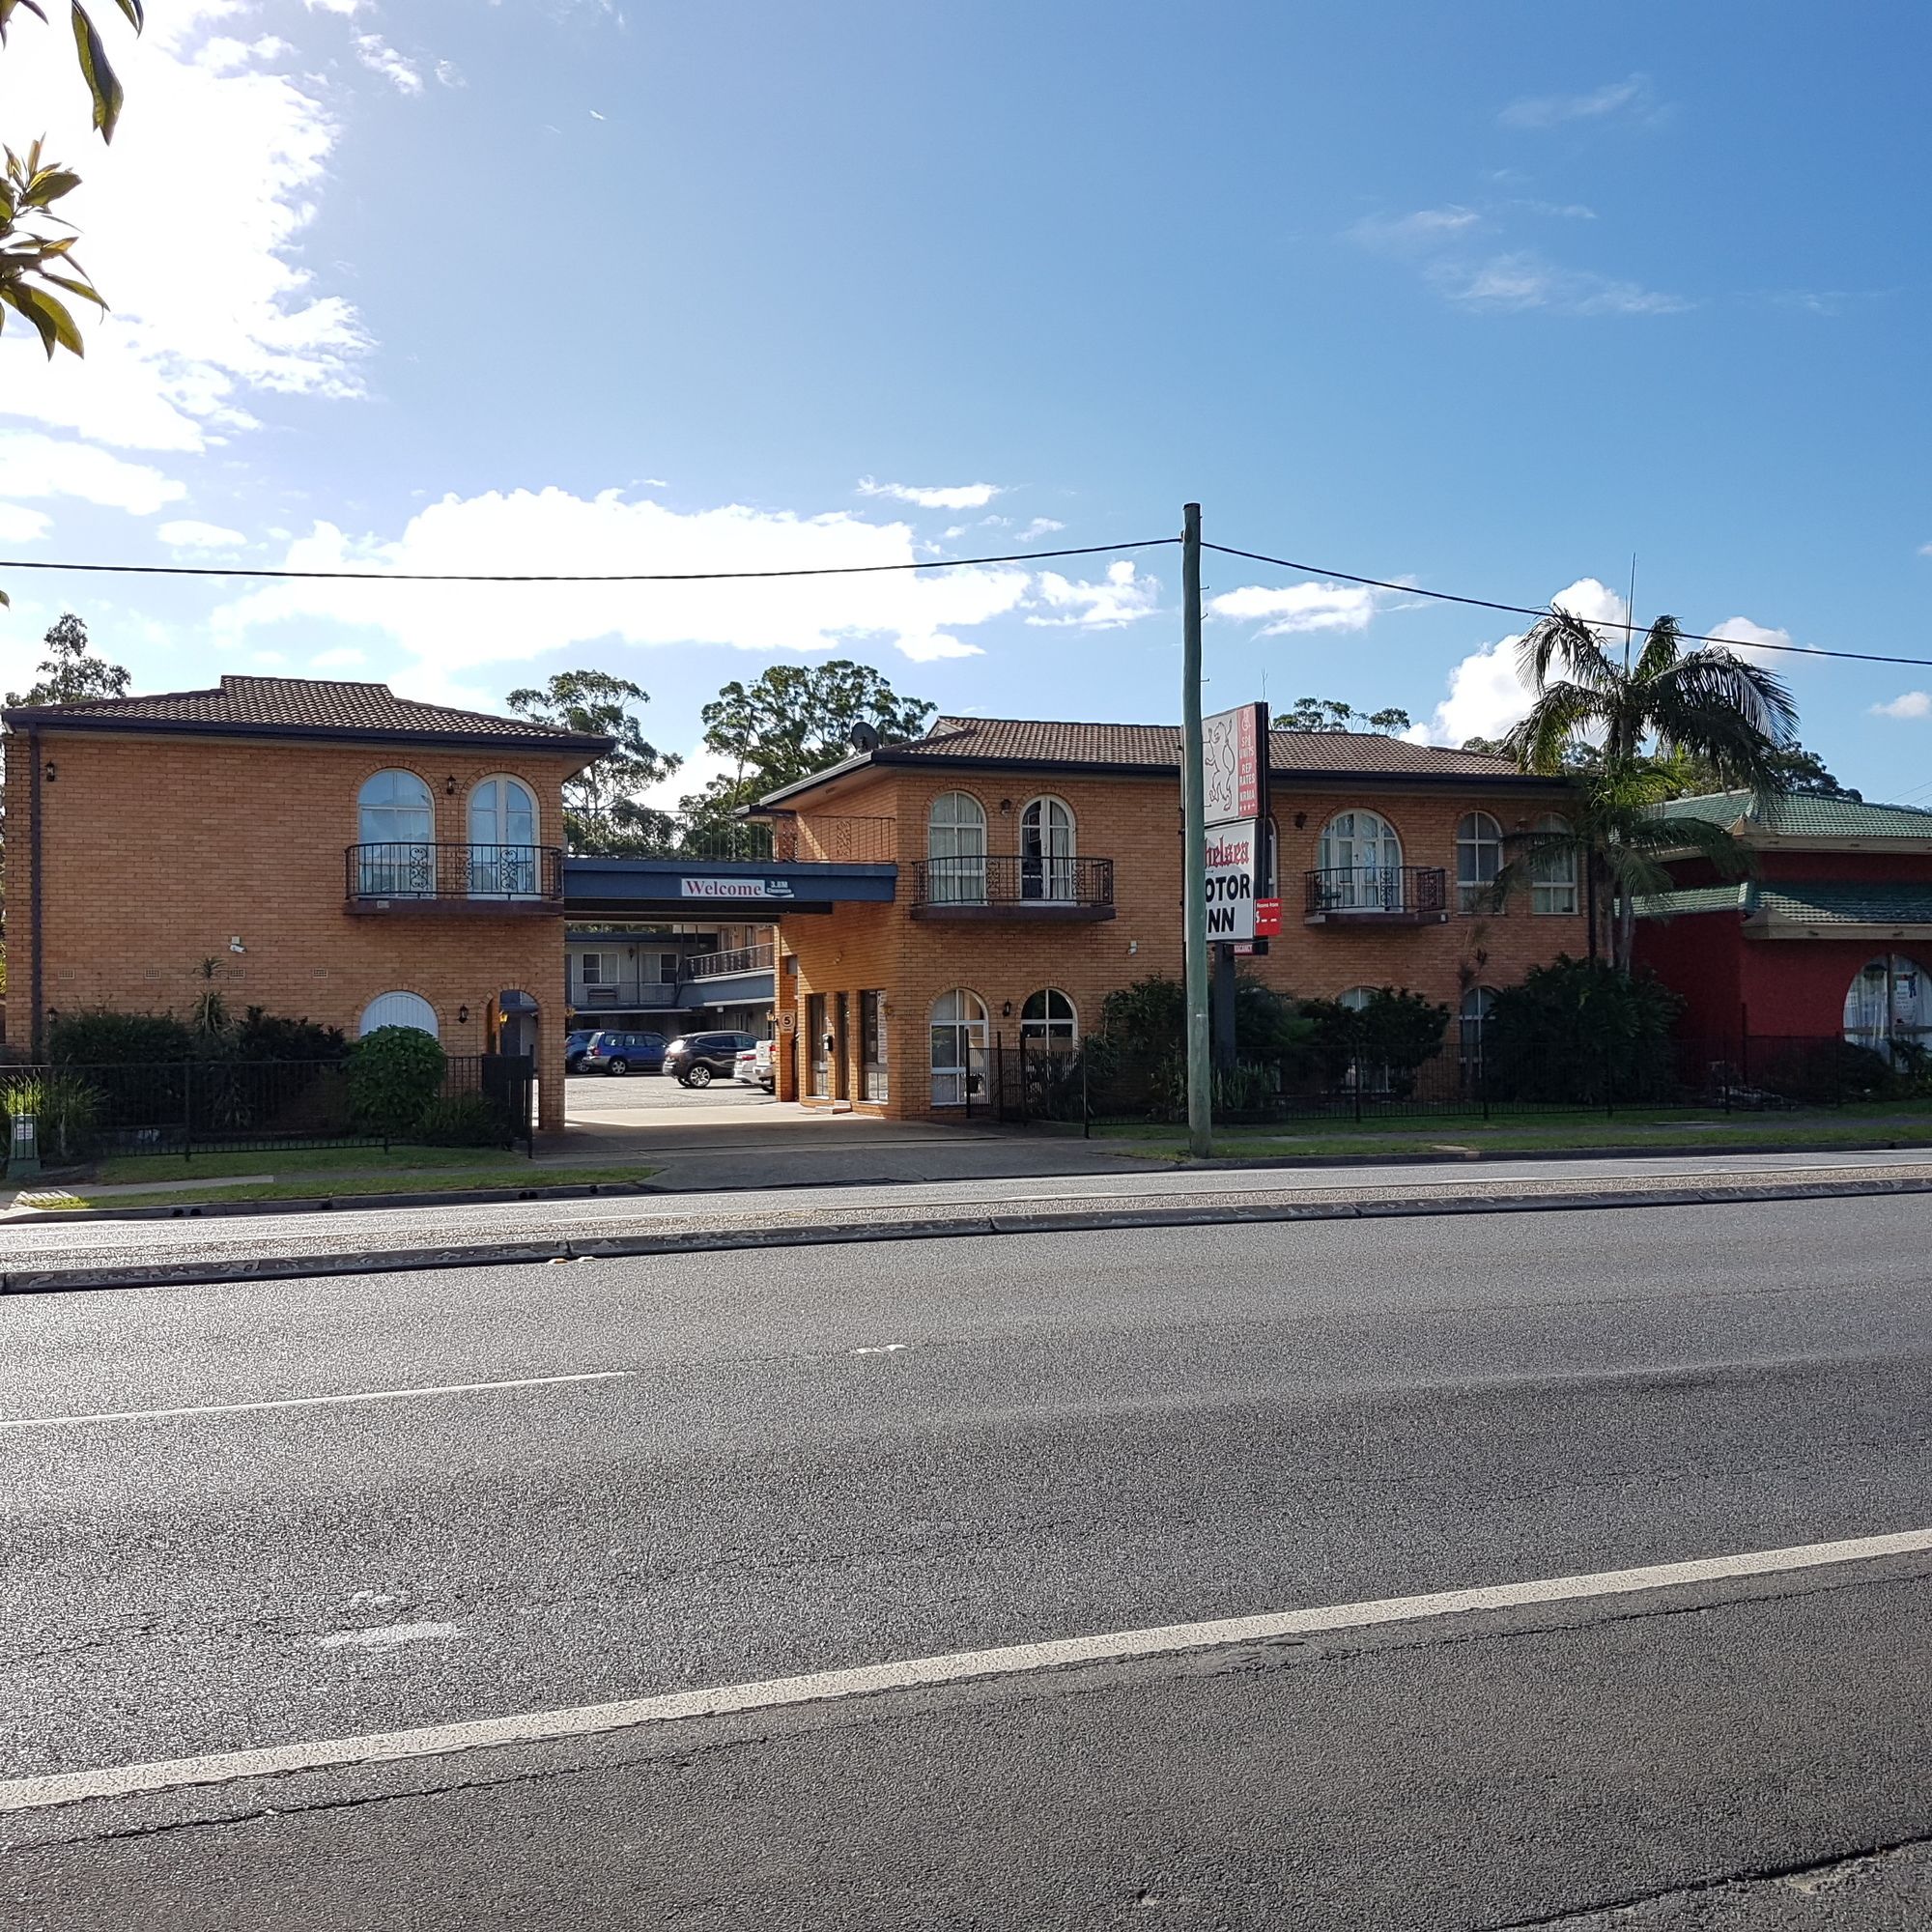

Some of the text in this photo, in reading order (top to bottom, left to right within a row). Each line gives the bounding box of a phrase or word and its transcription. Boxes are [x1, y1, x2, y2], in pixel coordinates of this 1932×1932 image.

[1241, 735, 1251, 747] SPA
[1239, 745, 1254, 759] UNITS
[1241, 762, 1252, 775] REP
[1239, 773, 1256, 786] RATES
[1205, 835, 1249, 868] helsea
[686, 880, 761, 896] Welcome
[1206, 873, 1251, 902] OTOR
[1206, 907, 1235, 934] NN
[784, 1016, 791, 1025] 5
